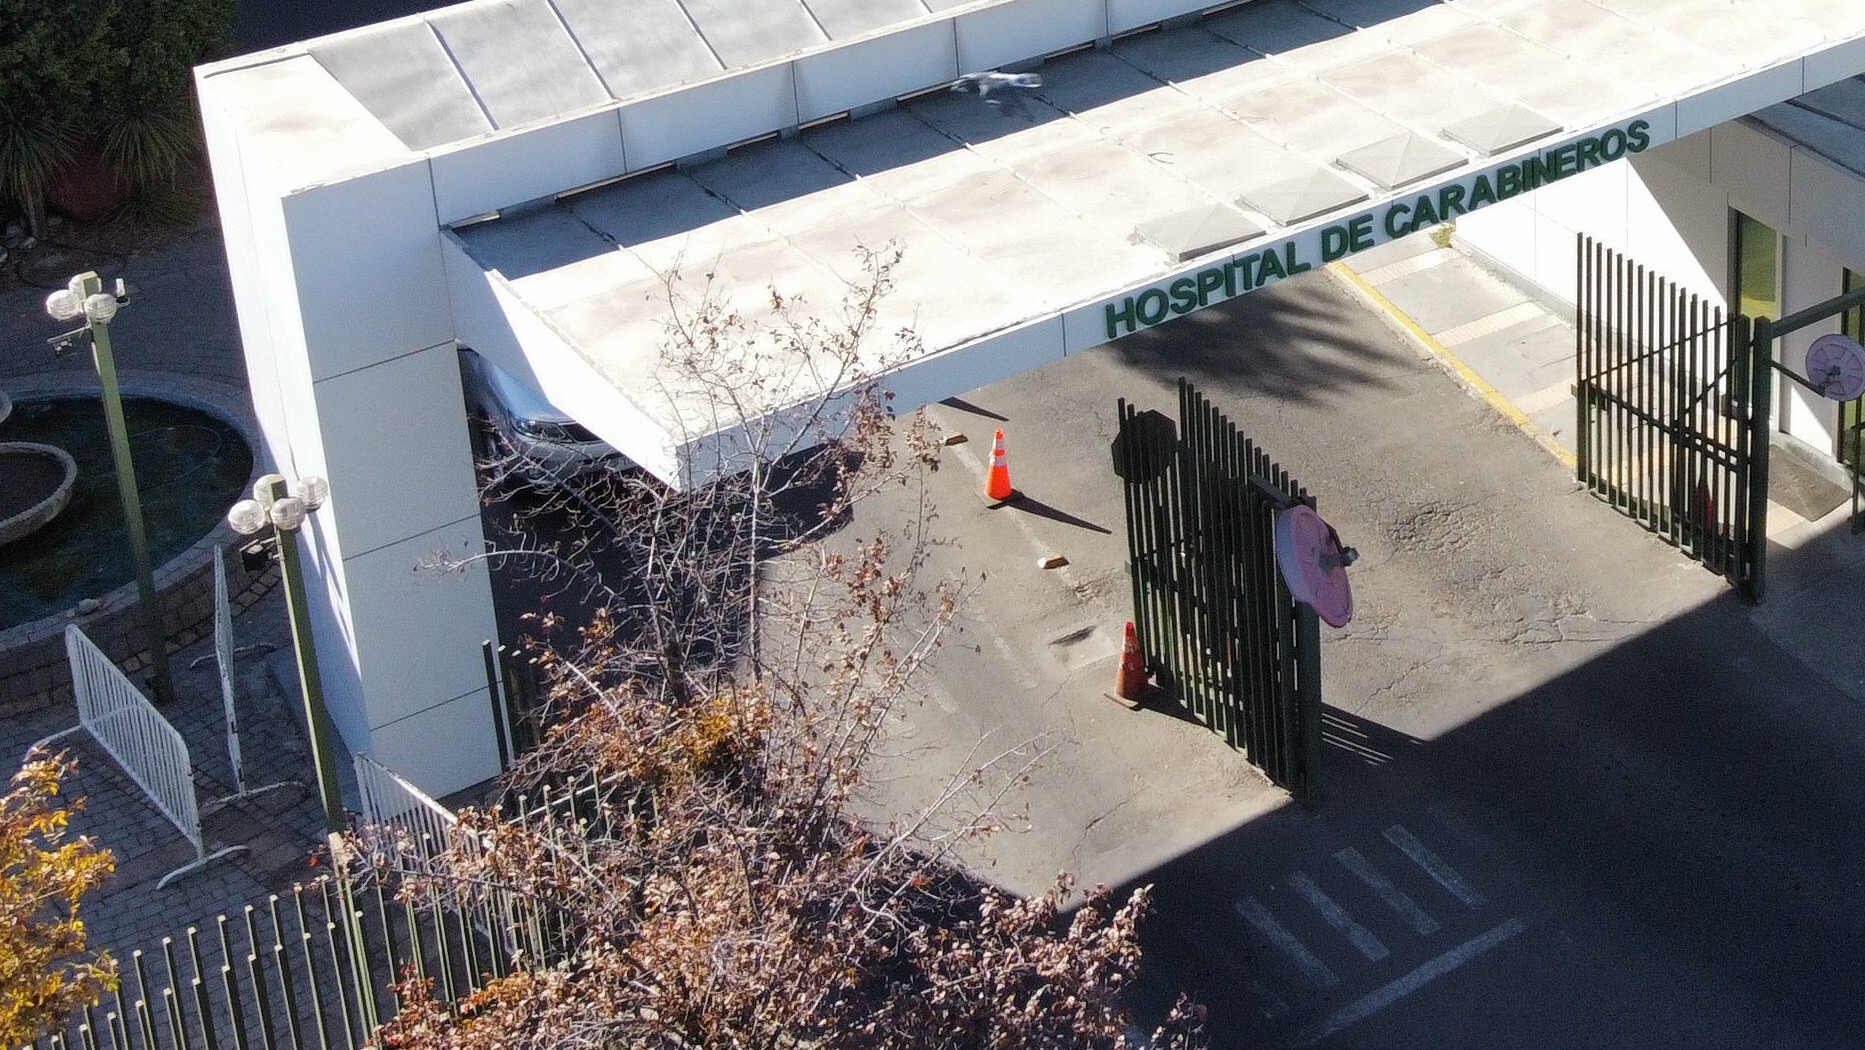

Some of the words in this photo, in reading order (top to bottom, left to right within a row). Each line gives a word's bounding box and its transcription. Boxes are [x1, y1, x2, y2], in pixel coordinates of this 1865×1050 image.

[1105, 241, 1311, 339] HOSPITAL
[1321, 214, 1375, 264] DE
[1384, 119, 1651, 238] CARABINEROS
